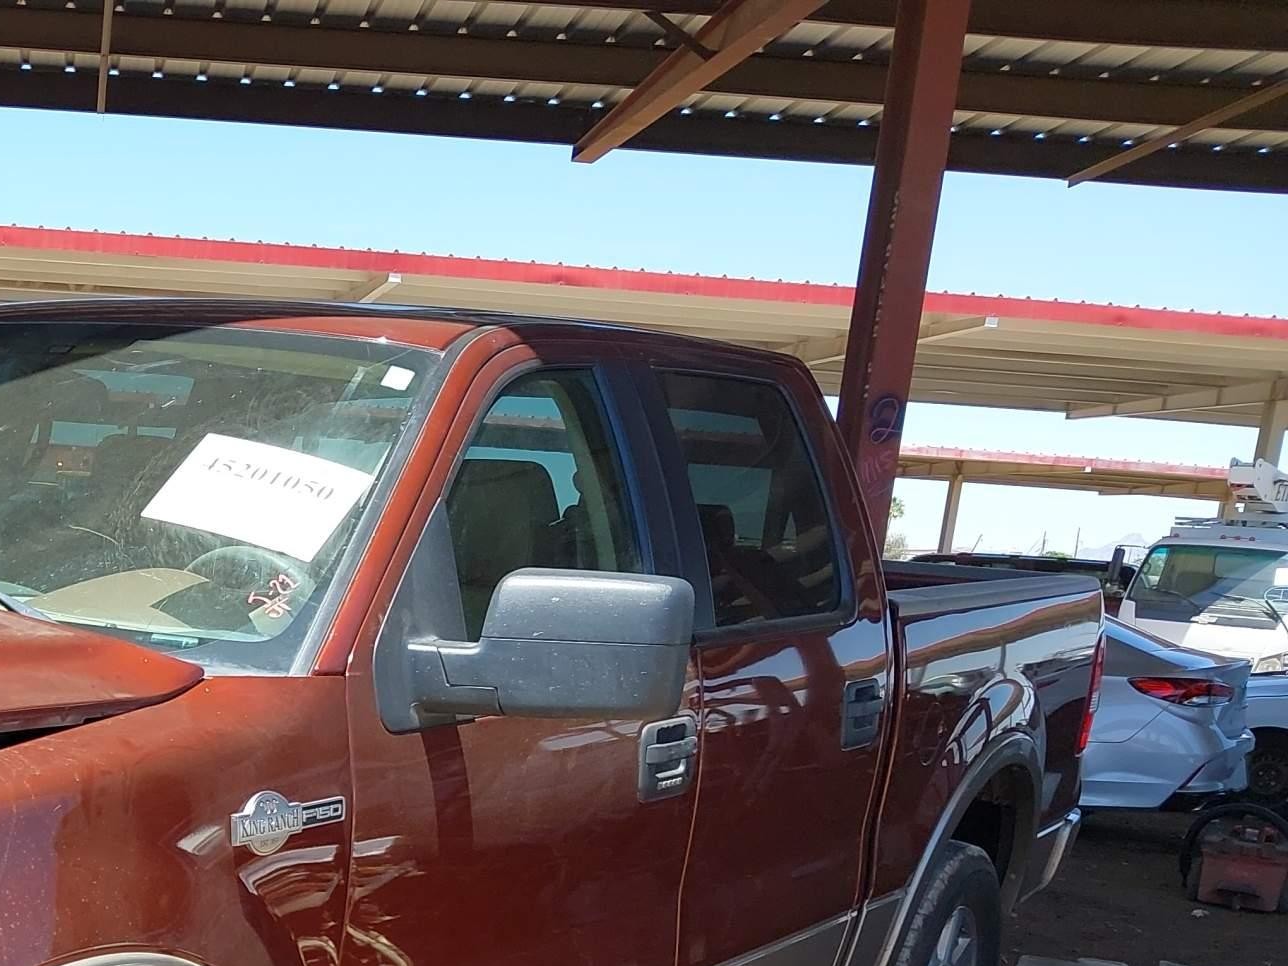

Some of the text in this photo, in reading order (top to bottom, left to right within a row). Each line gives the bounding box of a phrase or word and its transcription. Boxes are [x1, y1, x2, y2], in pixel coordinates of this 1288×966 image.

[199, 457, 334, 500] 45201050
[240, 807, 299, 838] KING RANCH
